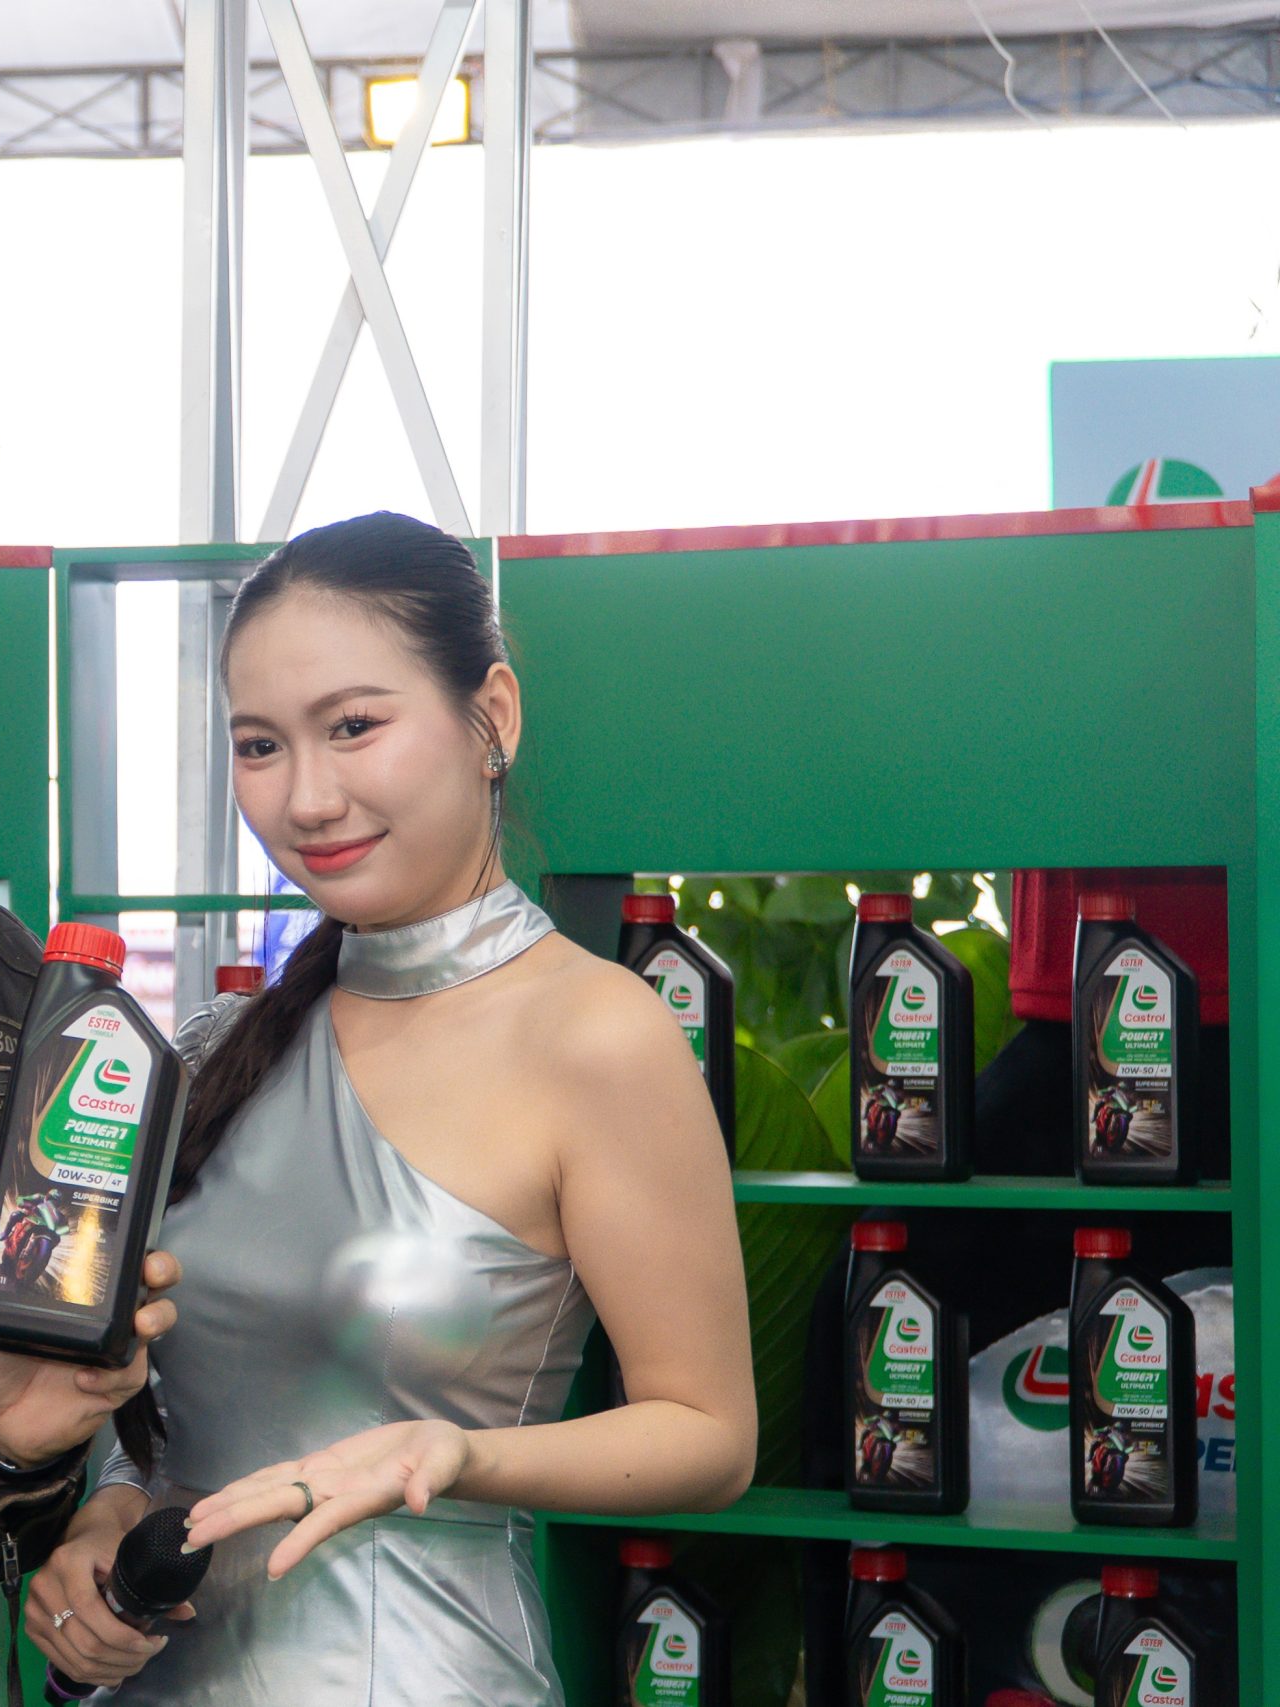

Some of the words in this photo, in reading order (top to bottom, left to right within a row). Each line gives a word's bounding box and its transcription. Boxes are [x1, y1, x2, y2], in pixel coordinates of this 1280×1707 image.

[1120, 959, 1143, 967] ESTER
[894, 1012, 933, 1023] Castrol
[1124, 1012, 1166, 1023] Castrol
[87, 1016, 121, 1032] ESTER
[1119, 1031, 1164, 1042] POWER1
[1121, 1066, 1154, 1075] 10W-50
[77, 1094, 136, 1115] Castrol
[64, 1118, 129, 1141] POWER1
[70, 1134, 118, 1150] ULTIMATE
[57, 1167, 103, 1185] 10W-50
[73, 1190, 120, 1207] SUPERBIKE
[888, 1344, 928, 1355] Castrol
[1120, 1353, 1162, 1364] Castrol
[1115, 1371, 1160, 1383] POWER1
[1140, 1638, 1164, 1648] ESTER
[655, 1661, 694, 1673] Castrol
[888, 1676, 928, 1688] Castrol
[1143, 1694, 1185, 1706] Castrol
